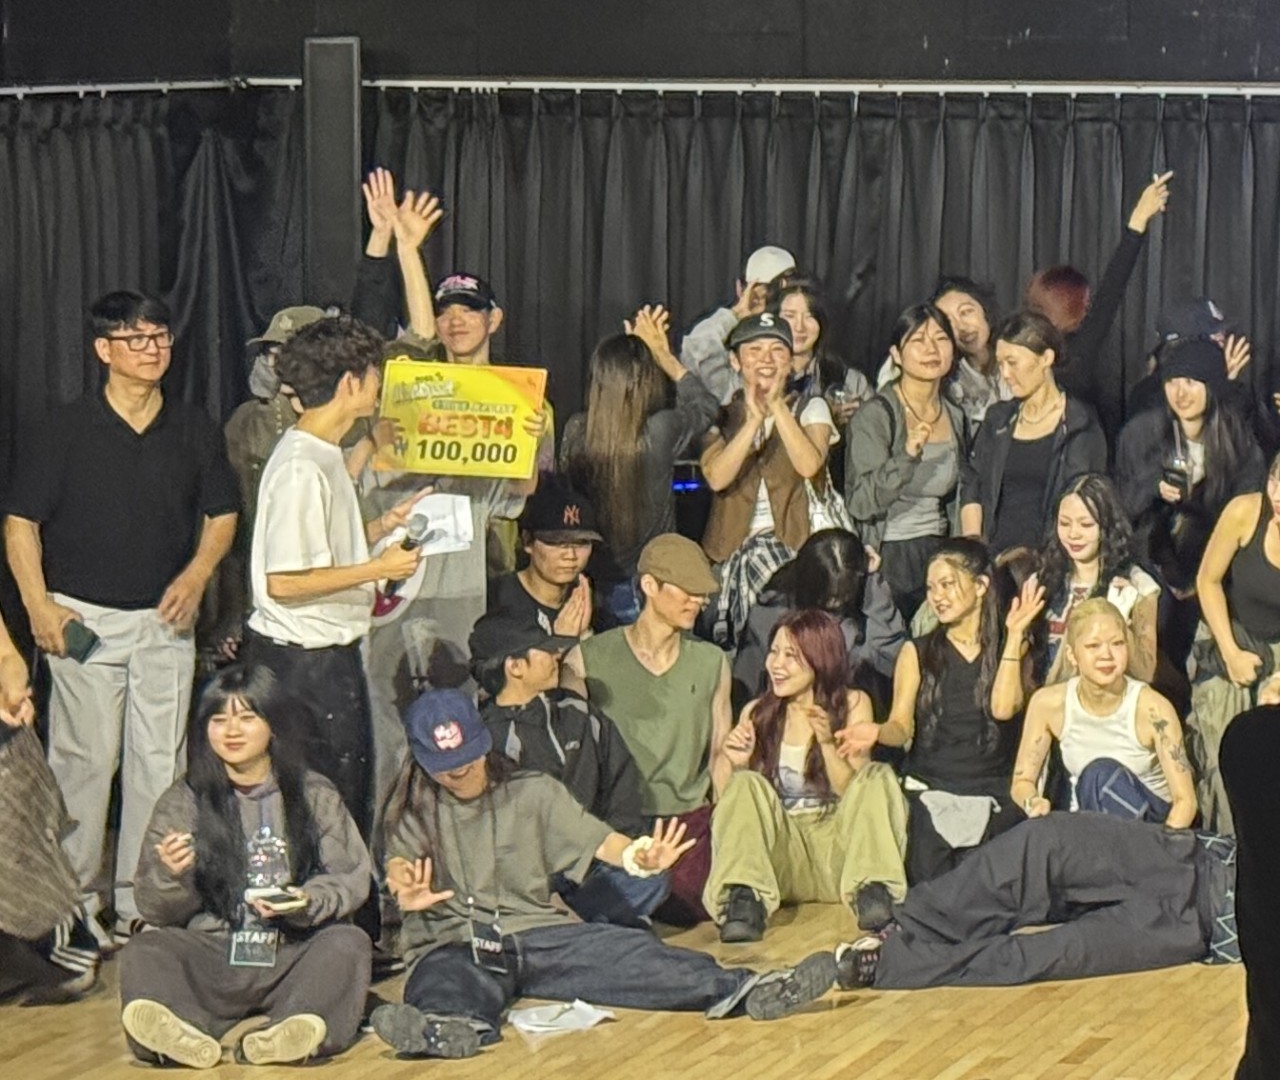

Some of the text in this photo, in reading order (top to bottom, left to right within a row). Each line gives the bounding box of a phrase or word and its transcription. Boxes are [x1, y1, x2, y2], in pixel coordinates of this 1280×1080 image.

[759, 312, 774, 327] S
[417, 413, 514, 440] BEST4
[416, 440, 518, 465] 100,000
[236, 931, 275, 945] STAFF
[473, 936, 502, 954] STAFF
